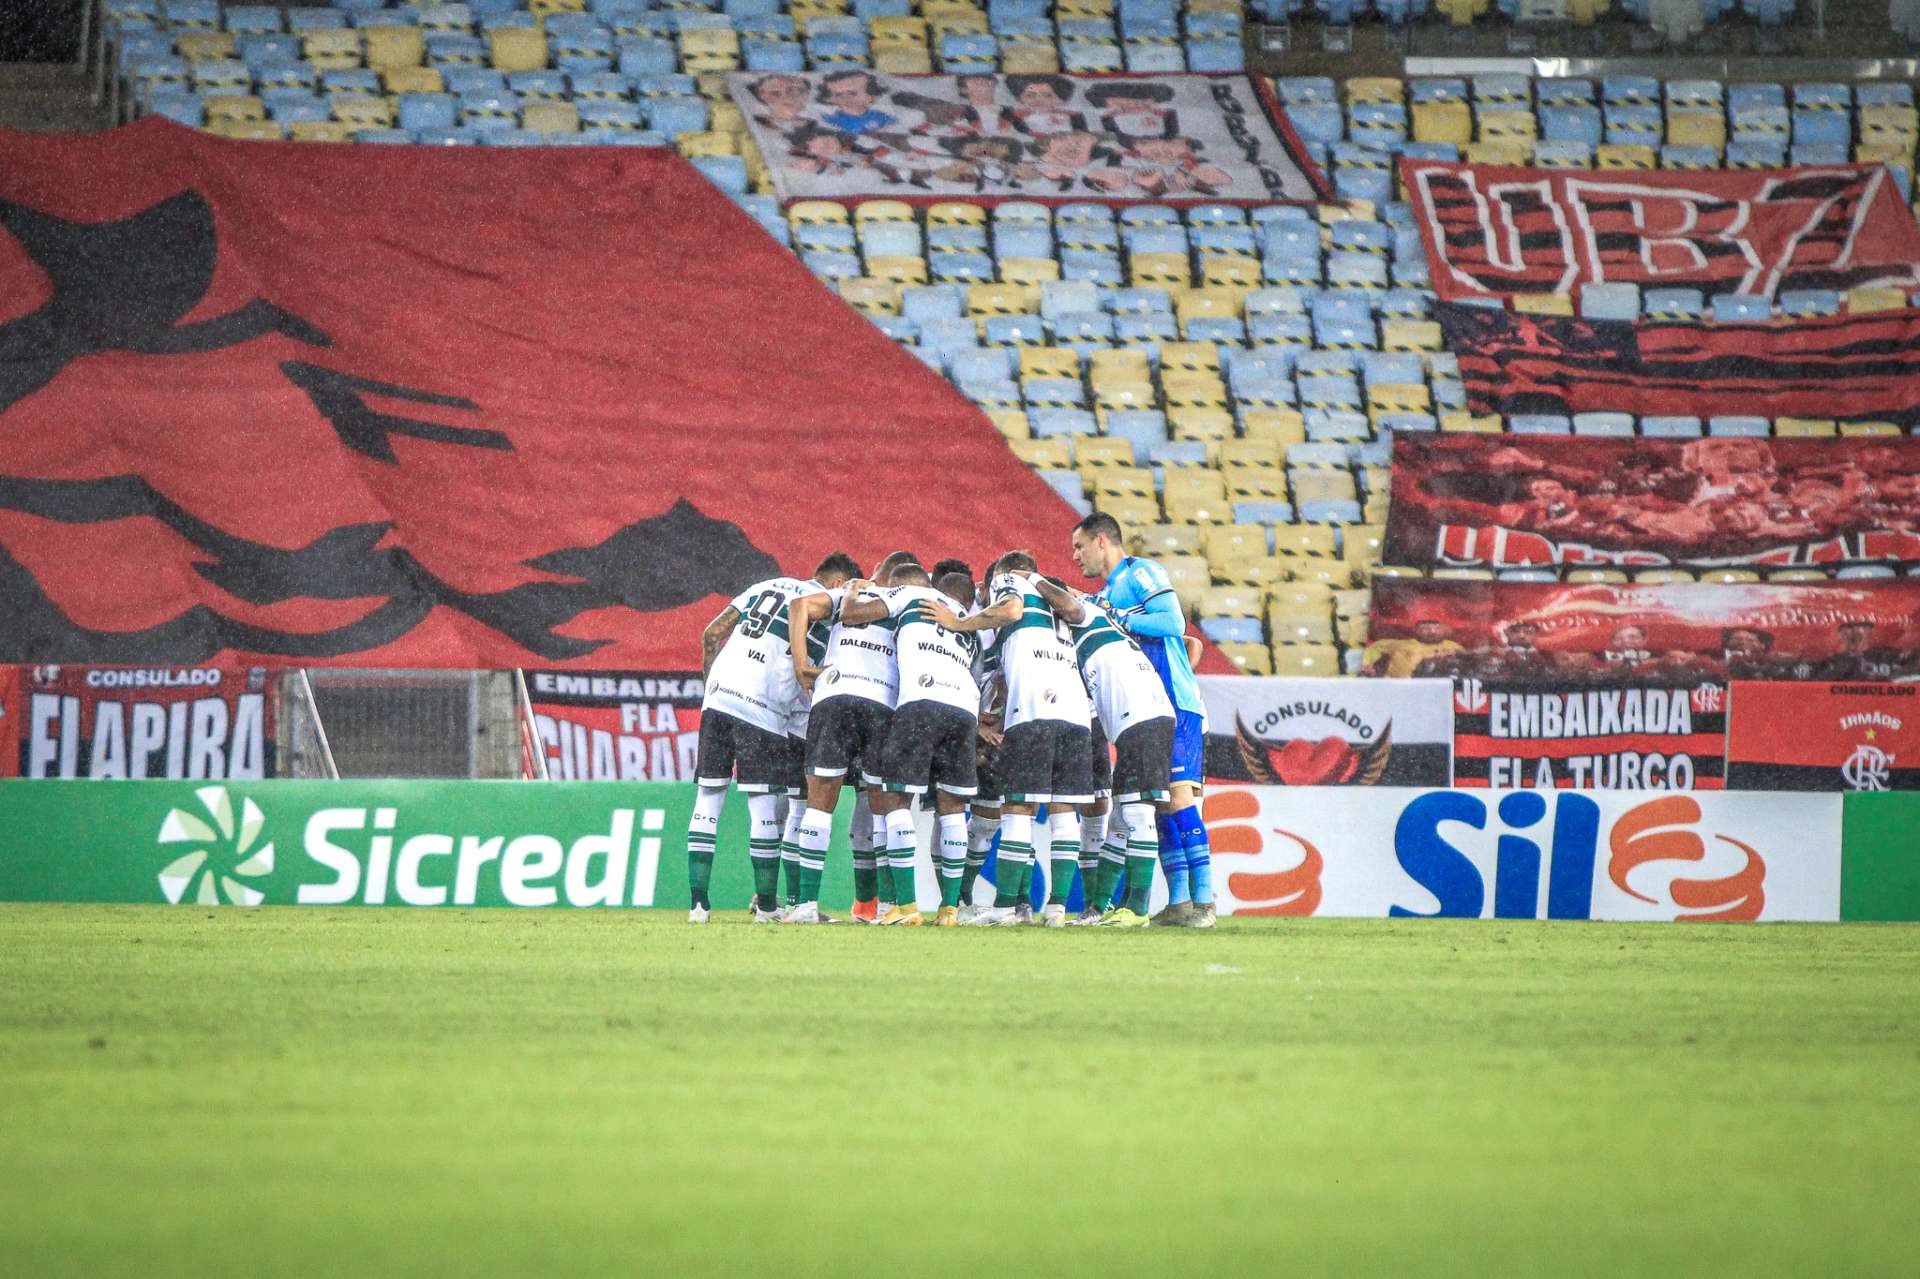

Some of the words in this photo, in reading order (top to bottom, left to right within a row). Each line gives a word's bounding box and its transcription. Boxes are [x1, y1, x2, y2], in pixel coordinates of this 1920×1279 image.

[740, 590, 786, 640] 9
[748, 649, 766, 664] VAL
[840, 638, 893, 657] DALBERTO
[86, 669, 222, 687] CONSULADO
[1830, 686, 1916, 697] CONSULADO
[620, 703, 679, 733] FLA
[1254, 701, 1374, 740] CONSULADO
[1490, 689, 1692, 738] EMBAIXADA
[1568, 751, 1695, 790] TURCO
[297, 808, 666, 907] Sicredi
[1389, 791, 1601, 920] Sil
